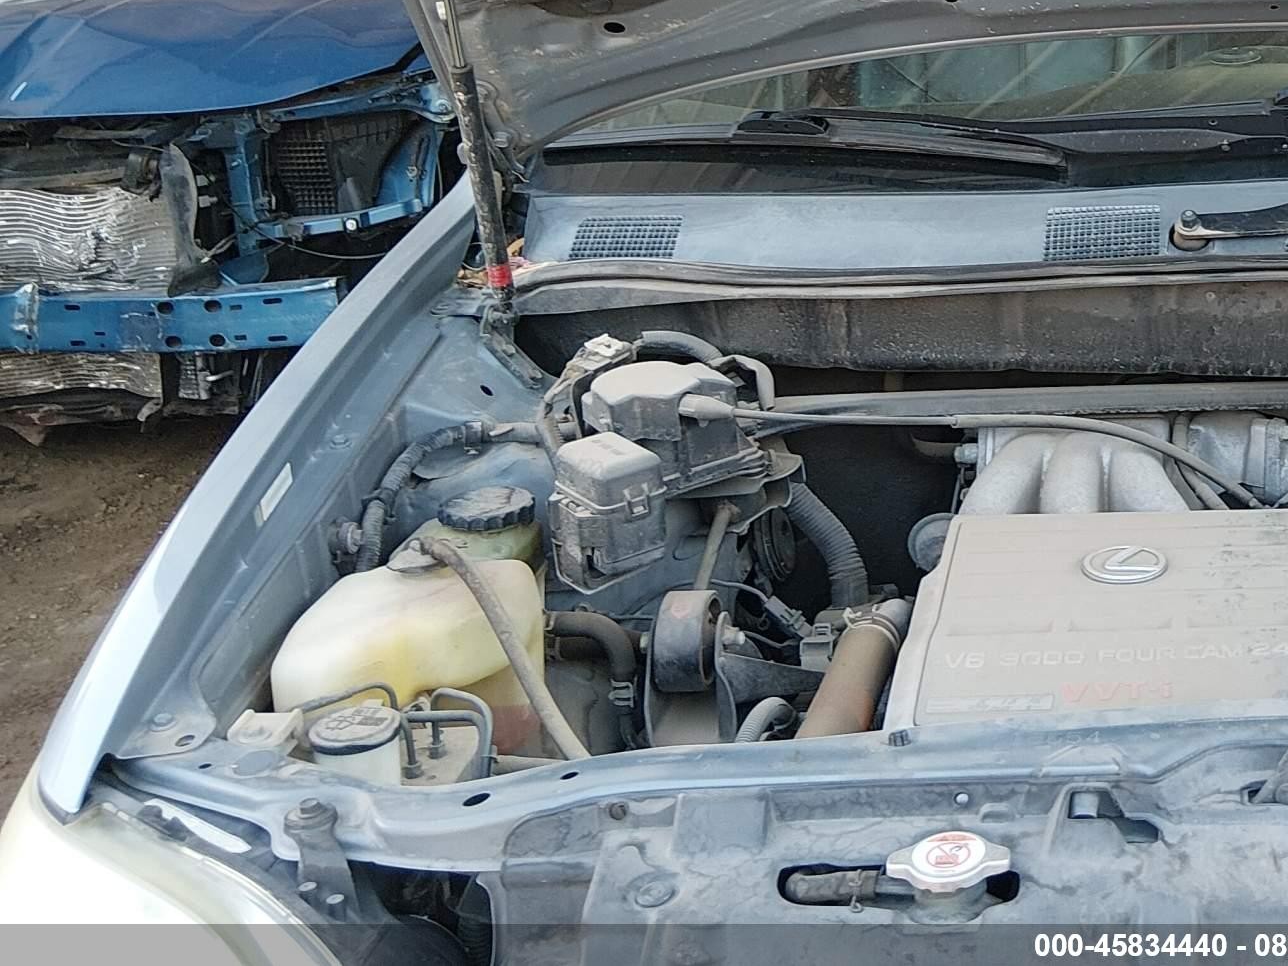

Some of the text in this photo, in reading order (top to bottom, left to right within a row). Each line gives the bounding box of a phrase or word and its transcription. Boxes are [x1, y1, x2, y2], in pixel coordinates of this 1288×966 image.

[944, 650, 985, 669] V6
[1000, 649, 1086, 667] 3000
[1098, 646, 1177, 663] FOUR
[1184, 644, 1243, 659] CAM
